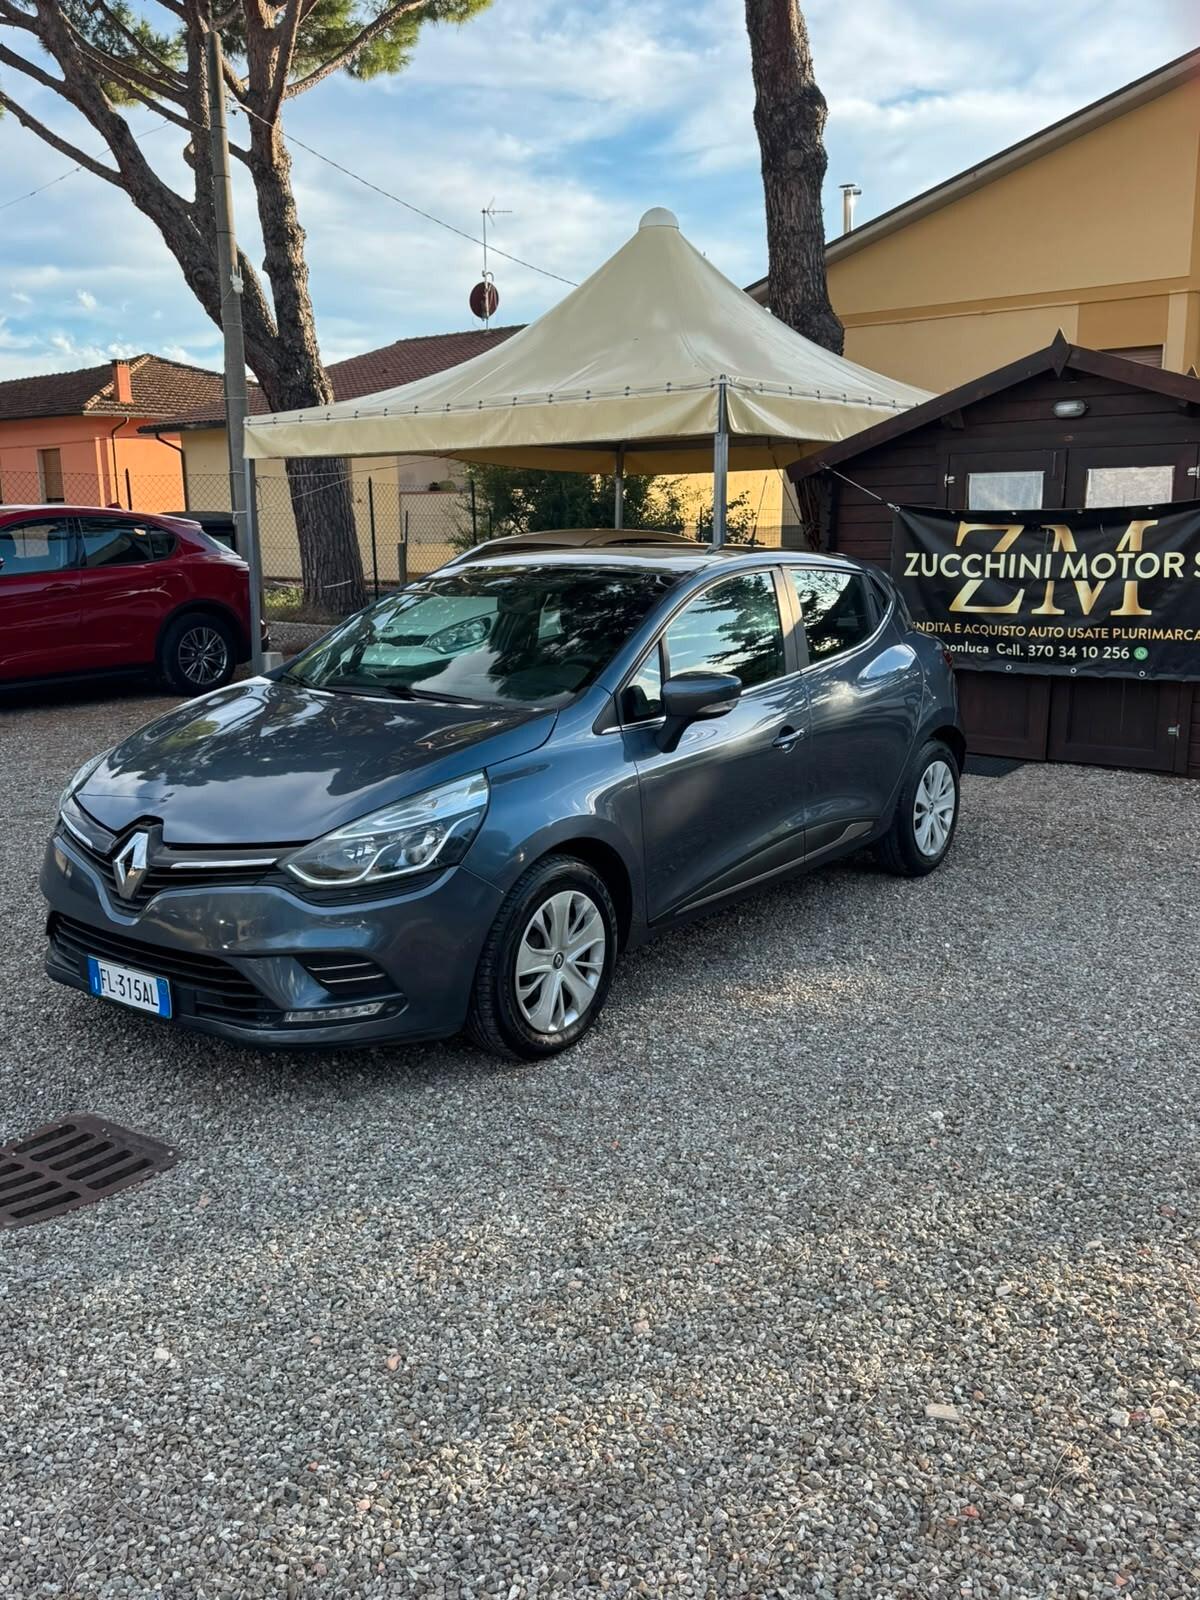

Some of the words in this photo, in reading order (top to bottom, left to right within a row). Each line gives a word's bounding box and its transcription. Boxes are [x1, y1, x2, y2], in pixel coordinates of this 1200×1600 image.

[903, 552, 1052, 580] ZUCCHINI
[911, 620, 952, 633] NDITA
[954, 623, 962, 633] E
[963, 624, 1027, 637] ACQUISTO
[1028, 626, 1065, 638] AUTO
[1067, 627, 1109, 639] USATE
[996, 643, 1024, 656] Cell.
[1028, 645, 1054, 657] 370
[1058, 646, 1078, 658] 34
[1081, 646, 1099, 658] 10
[1102, 647, 1130, 659] 256
